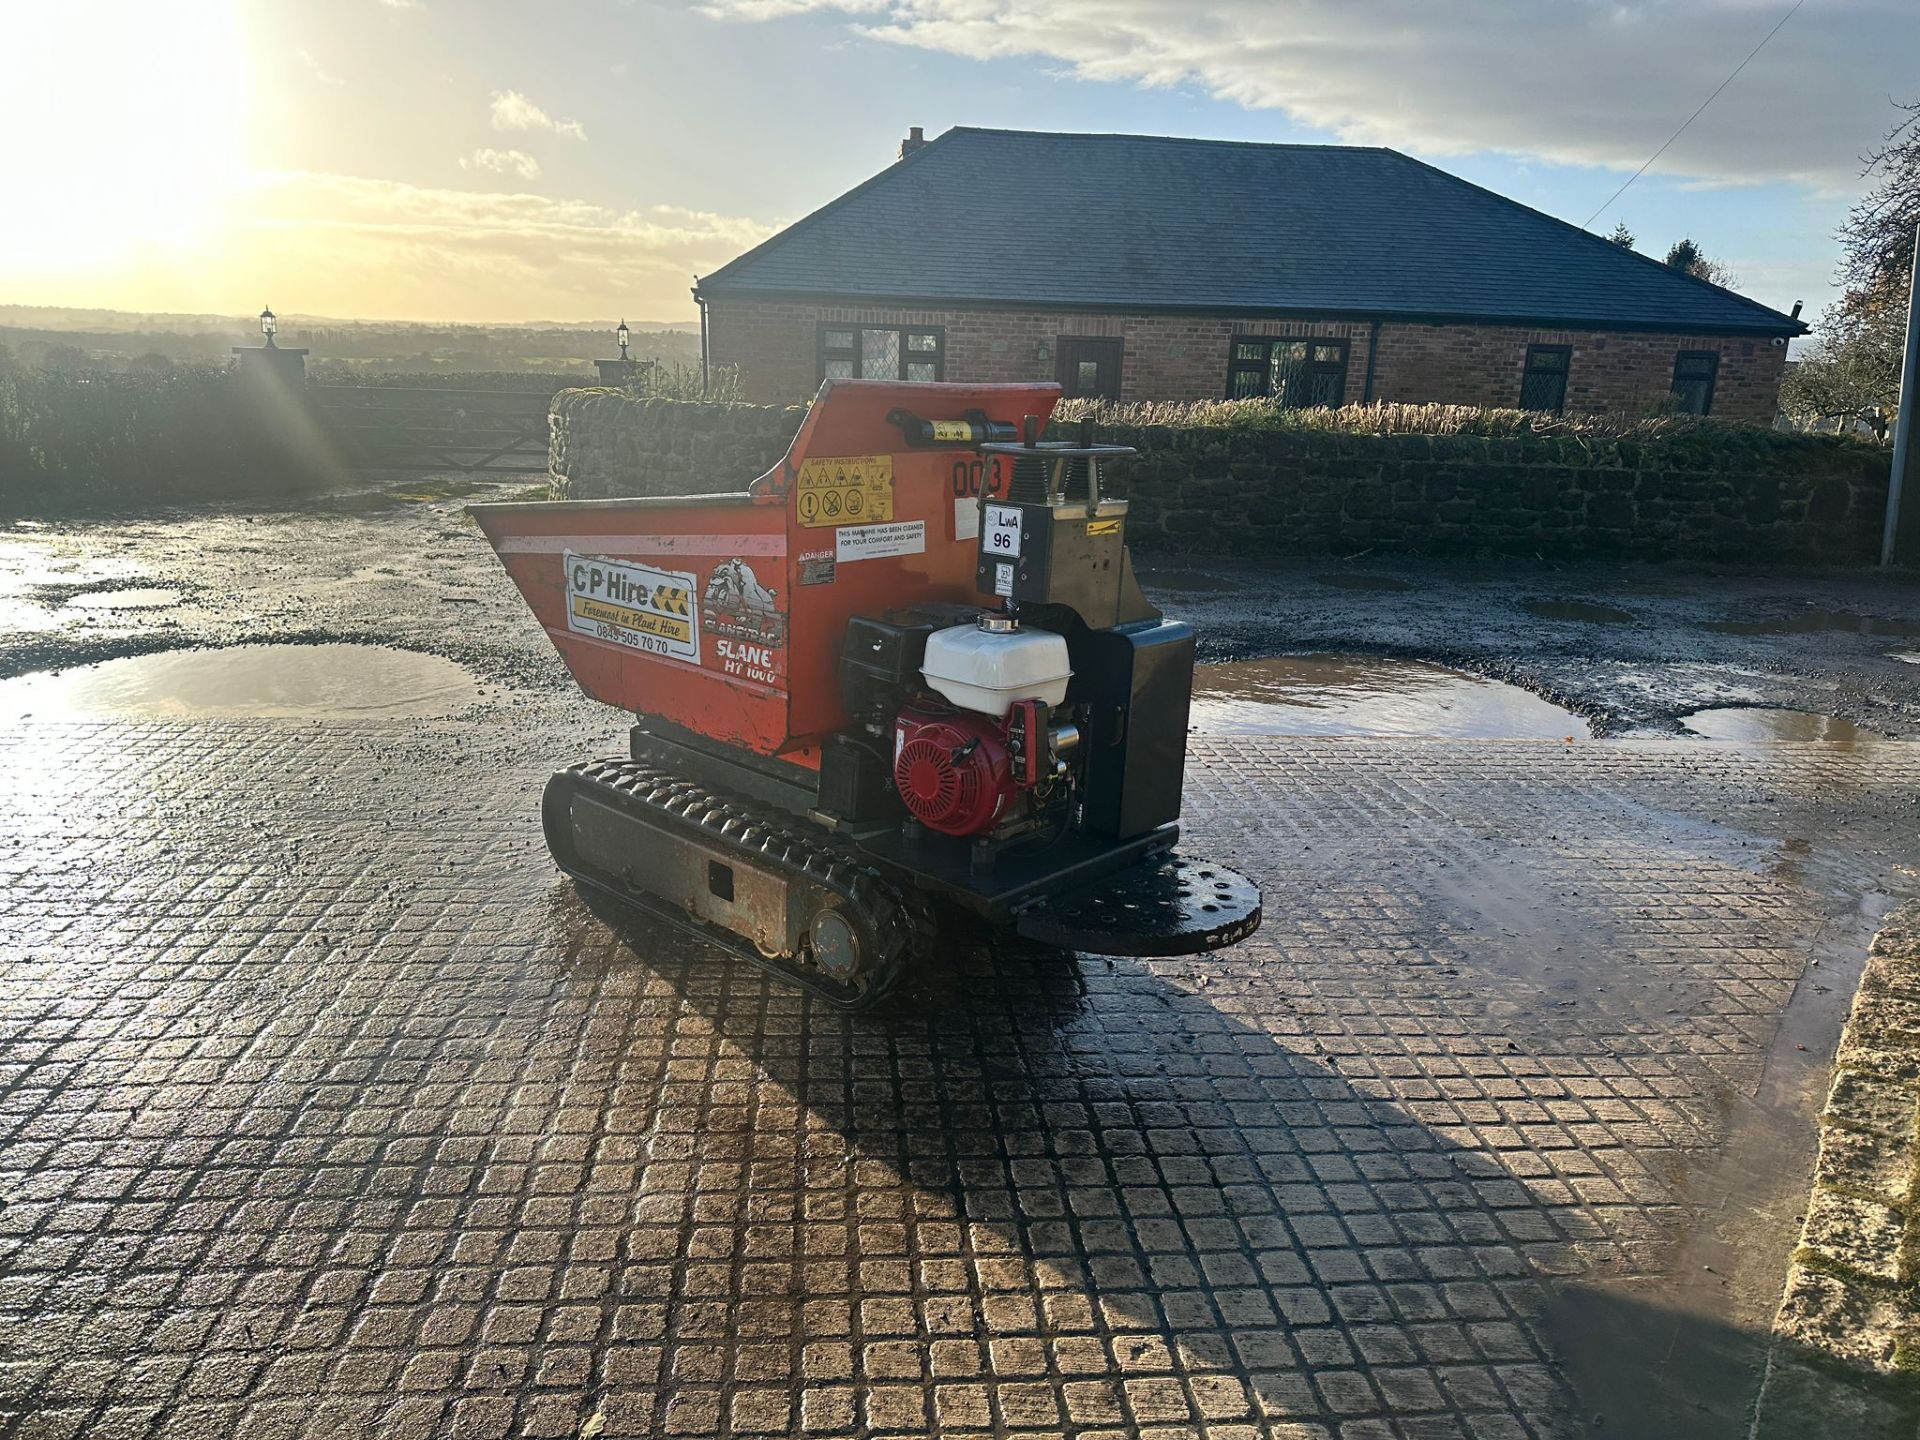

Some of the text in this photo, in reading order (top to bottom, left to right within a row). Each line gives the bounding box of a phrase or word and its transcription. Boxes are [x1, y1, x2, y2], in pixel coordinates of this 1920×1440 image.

[841, 539, 851, 547] FOR
[853, 538, 867, 546] YOUR
[868, 535, 893, 544] COMFORT
[906, 532, 922, 540] SAFETY
[889, 525, 901, 533] BEEN
[903, 523, 923, 531] CLEANED
[993, 532, 1011, 549] 96
[805, 550, 834, 560] DANGER
[606, 571, 648, 606] Hire
[583, 601, 680, 636] Foremost in Plant Hire
[596, 624, 668, 654] 0845 505 70 70
[716, 639, 772, 668] SLANE
[724, 659, 776, 684] HT 1000
